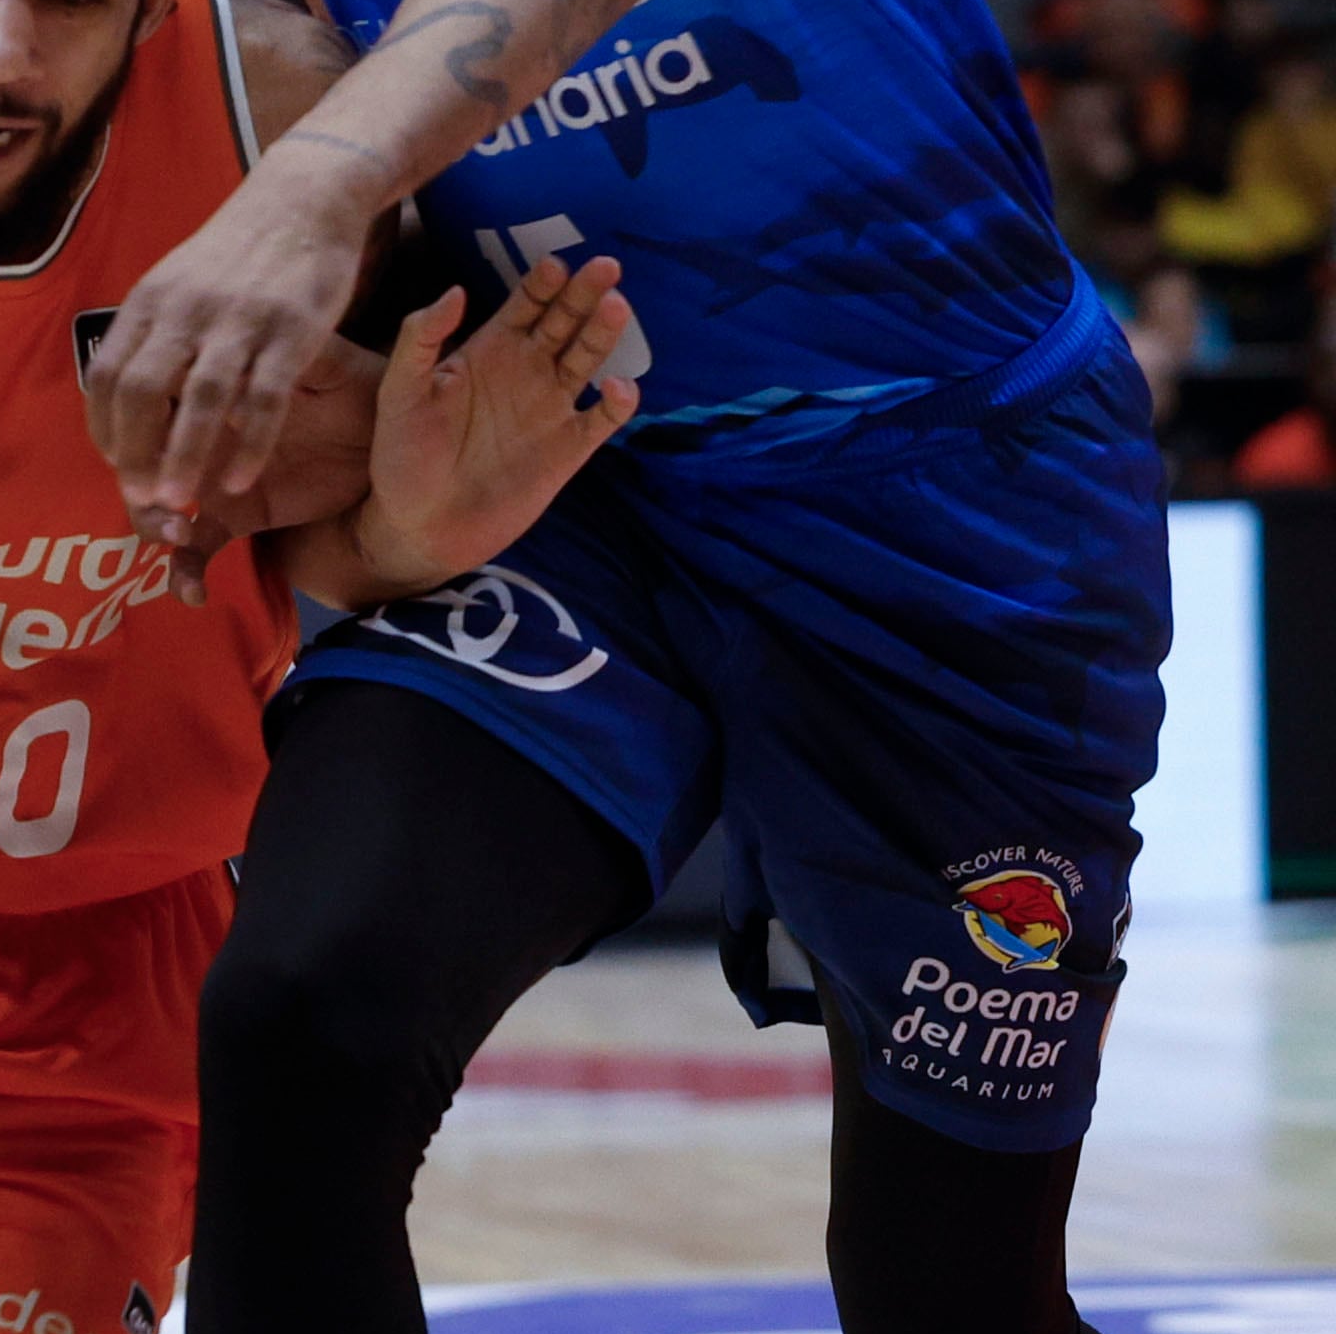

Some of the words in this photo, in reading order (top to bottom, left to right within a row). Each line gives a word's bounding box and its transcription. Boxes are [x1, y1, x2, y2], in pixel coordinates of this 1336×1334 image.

[457, 30, 713, 160] naria
[940, 845, 1027, 881] ISCOVER
[1035, 848, 1085, 898] NATURE
[901, 957, 1080, 1022] Poema
[892, 1007, 968, 1057] del
[981, 1026, 1067, 1069] Mar
[881, 1048, 1055, 1101] AQUARIUM
